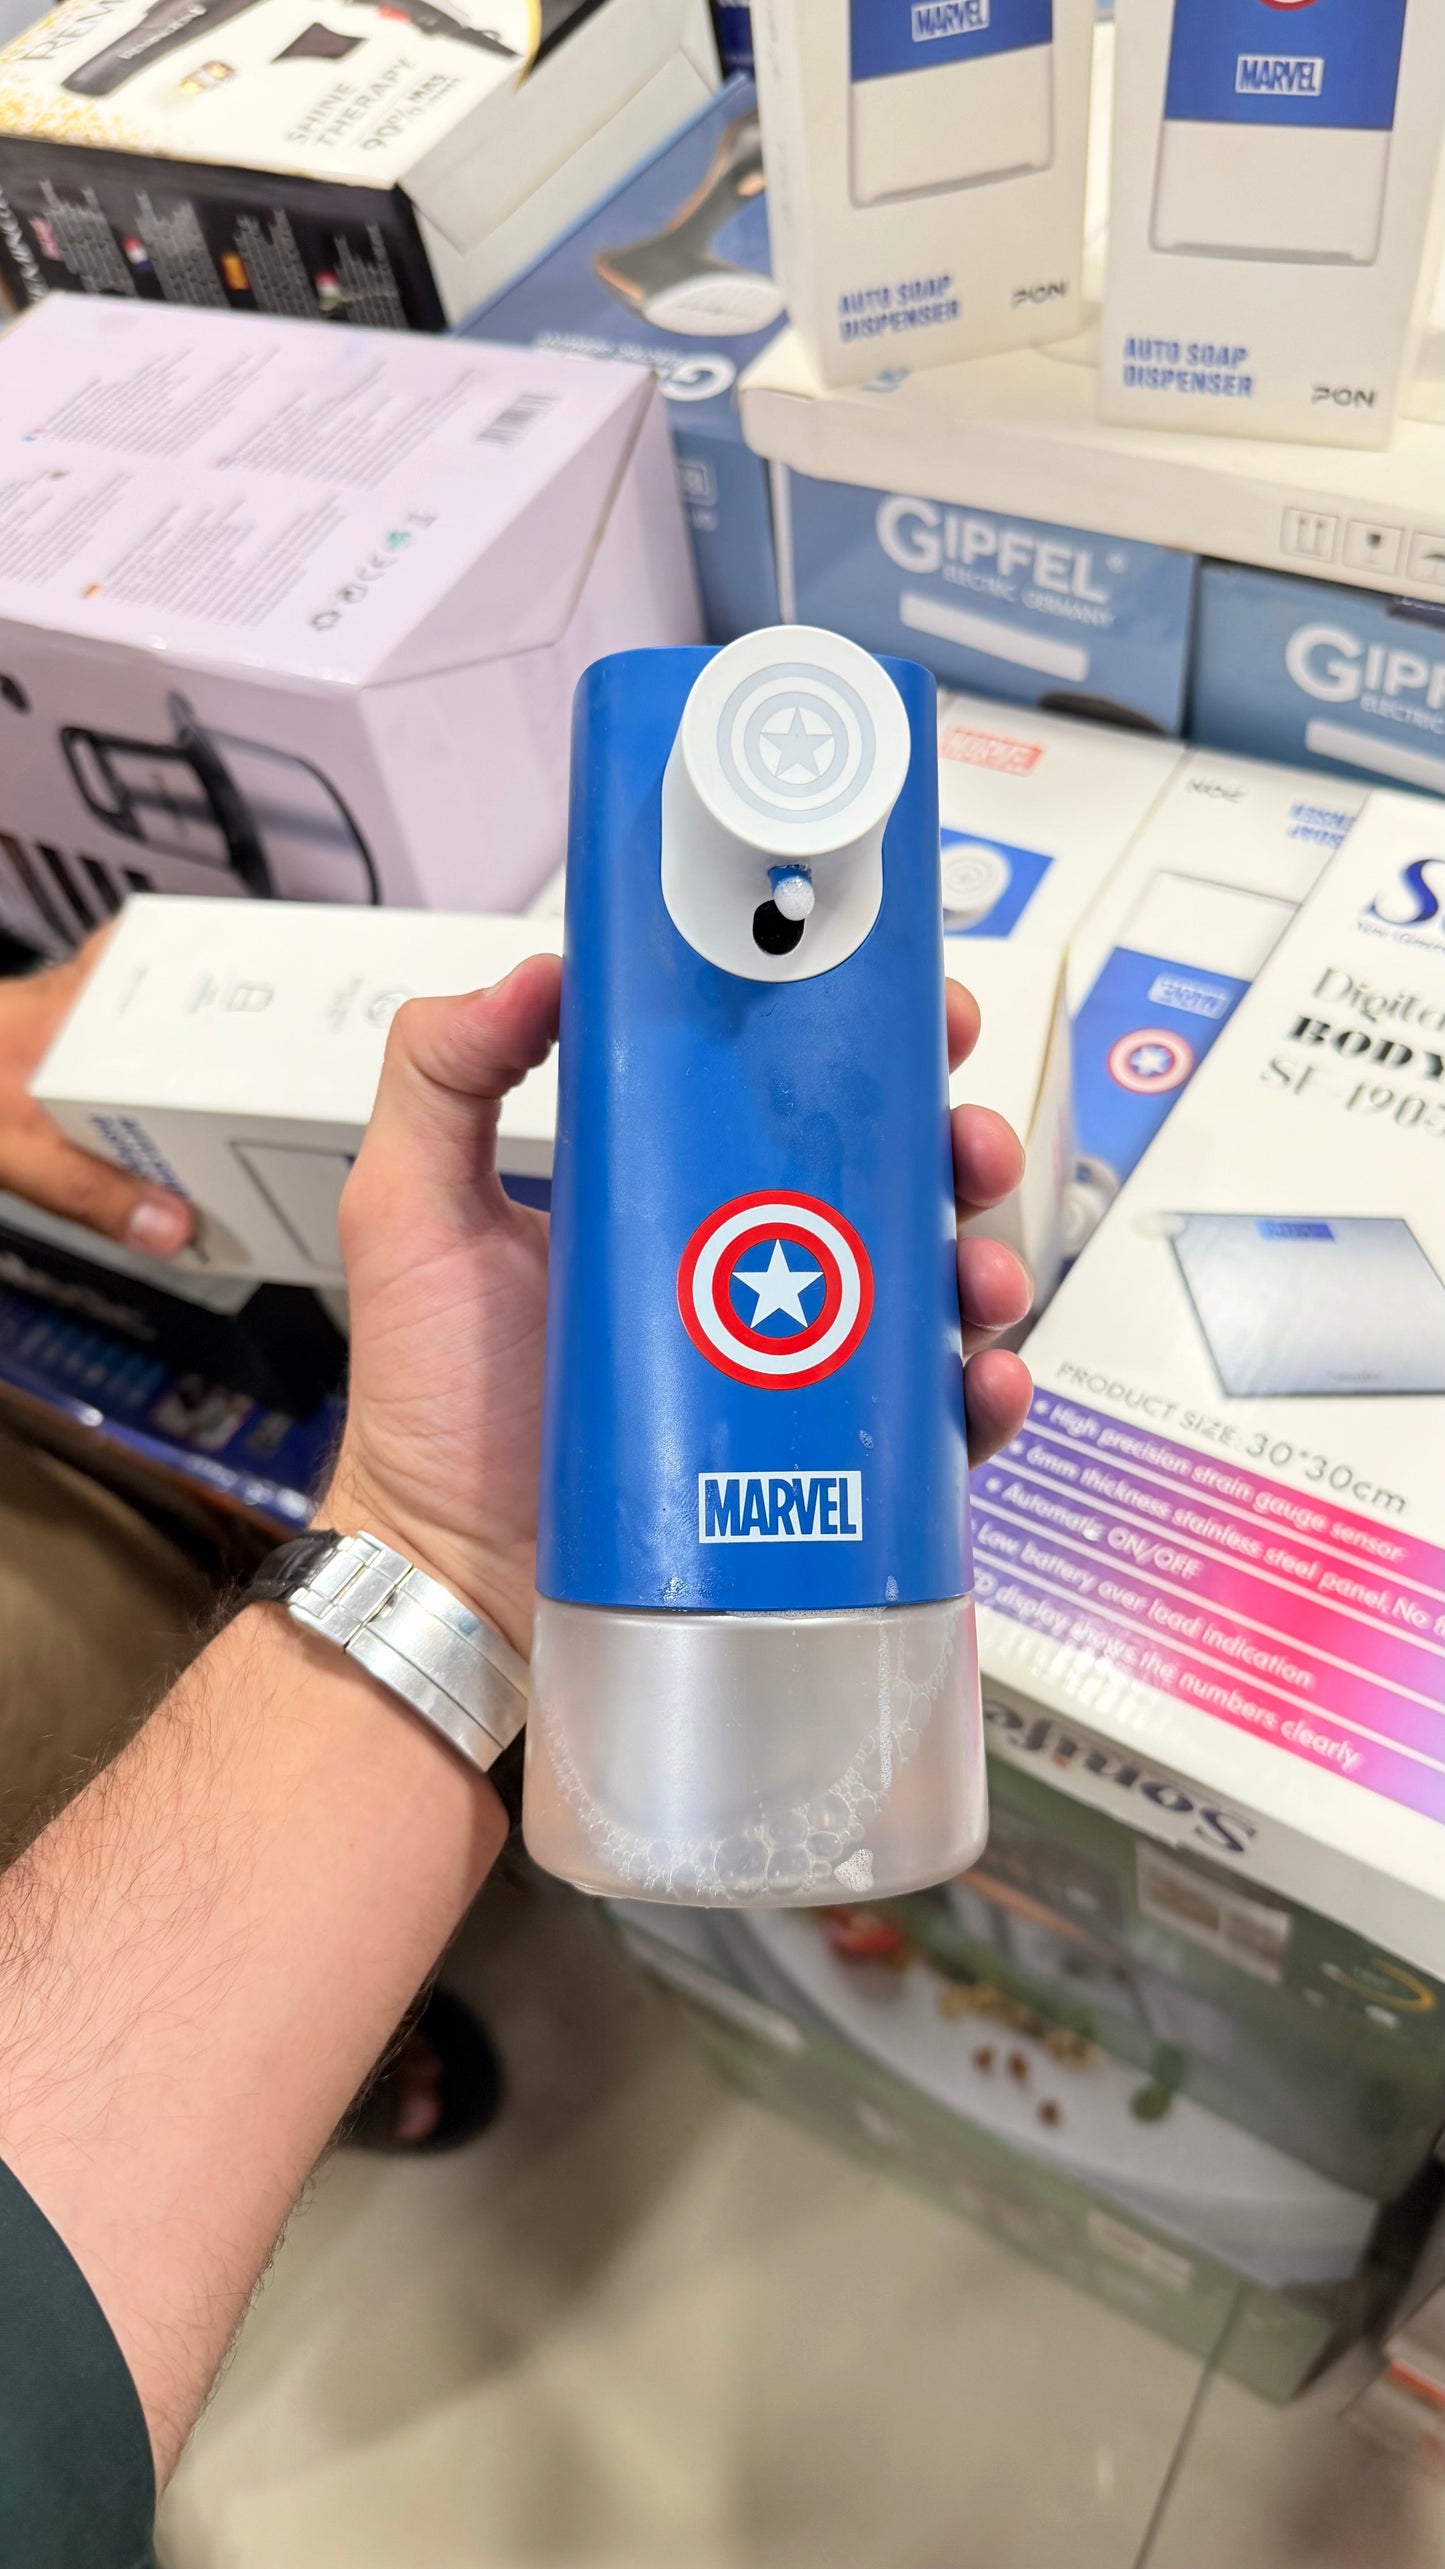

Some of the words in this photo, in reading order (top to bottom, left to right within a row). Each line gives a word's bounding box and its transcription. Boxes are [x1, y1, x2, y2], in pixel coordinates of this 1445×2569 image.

[916, 0, 988, 39] MARVEL
[315, 57, 414, 147] THERAPY
[1239, 58, 1319, 92] MARVEL
[284, 82, 354, 143] SHINE
[839, 287, 891, 314] AUTO
[897, 274, 952, 302] SOAP
[840, 300, 960, 341] DISPENSER
[1123, 337, 1181, 364] AUTO
[1186, 342, 1249, 369] SOAP
[1123, 364, 1254, 398] DISPENSER
[1311, 386, 1378, 408] PON
[1056, 1360, 1179, 1420] PRODUCT
[704, 1477, 858, 1538] MARVEL
[1025, 1444, 1082, 1482] 6mm
[1079, 1466, 1175, 1521] thickness
[1171, 1507, 1265, 1560] stainless
[1262, 1546, 1322, 1581] steel
[1049, 1402, 1101, 1439] High
[1096, 1426, 1194, 1477] precision
[1190, 1464, 1255, 1503] strain
[1251, 1490, 1331, 1533] gauge
[1328, 1520, 1408, 1563] sensor
[1001, 1481, 1107, 1542] Automatic
[1106, 1525, 1205, 1581] ON/OFF
[976, 1521, 1023, 1557] Low
[1020, 1540, 1099, 1594] battery
[1097, 1579, 1149, 1612] over
[1147, 1597, 1204, 1640] load
[1201, 1622, 1318, 1691] indication
[994, 1583, 1073, 1638] display
[1068, 1619, 1141, 1666] shows
[1138, 1650, 1180, 1684] the
[1177, 1671, 1281, 1733] numbers
[1279, 1718, 1367, 1774] clearly
[982, 1700, 1257, 1853] Sonife
